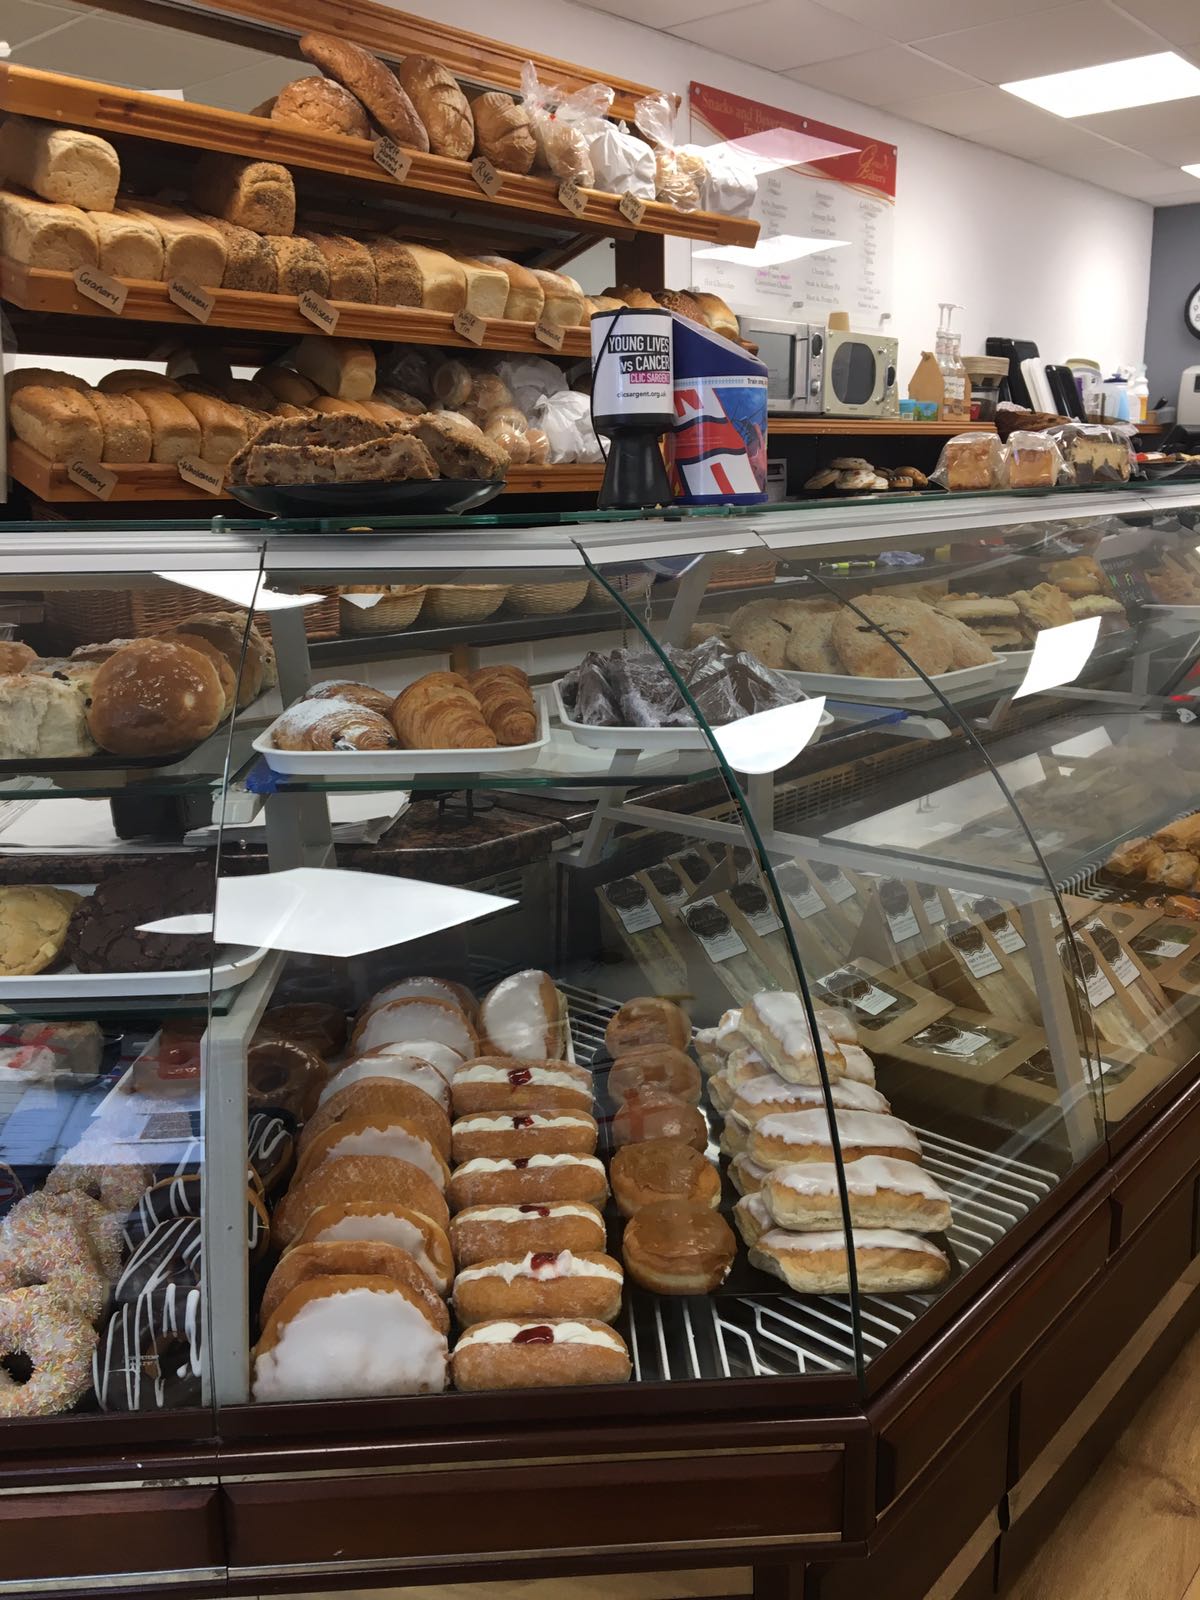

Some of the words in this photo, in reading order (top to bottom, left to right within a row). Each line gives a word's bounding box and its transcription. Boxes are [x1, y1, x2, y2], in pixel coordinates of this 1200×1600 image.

[477, 160, 494, 185] Rye
[609, 336, 644, 352] YOUNG
[646, 336, 669, 353] LIVES
[635, 355, 670, 371] CANCER
[630, 373, 646, 383] CLIC
